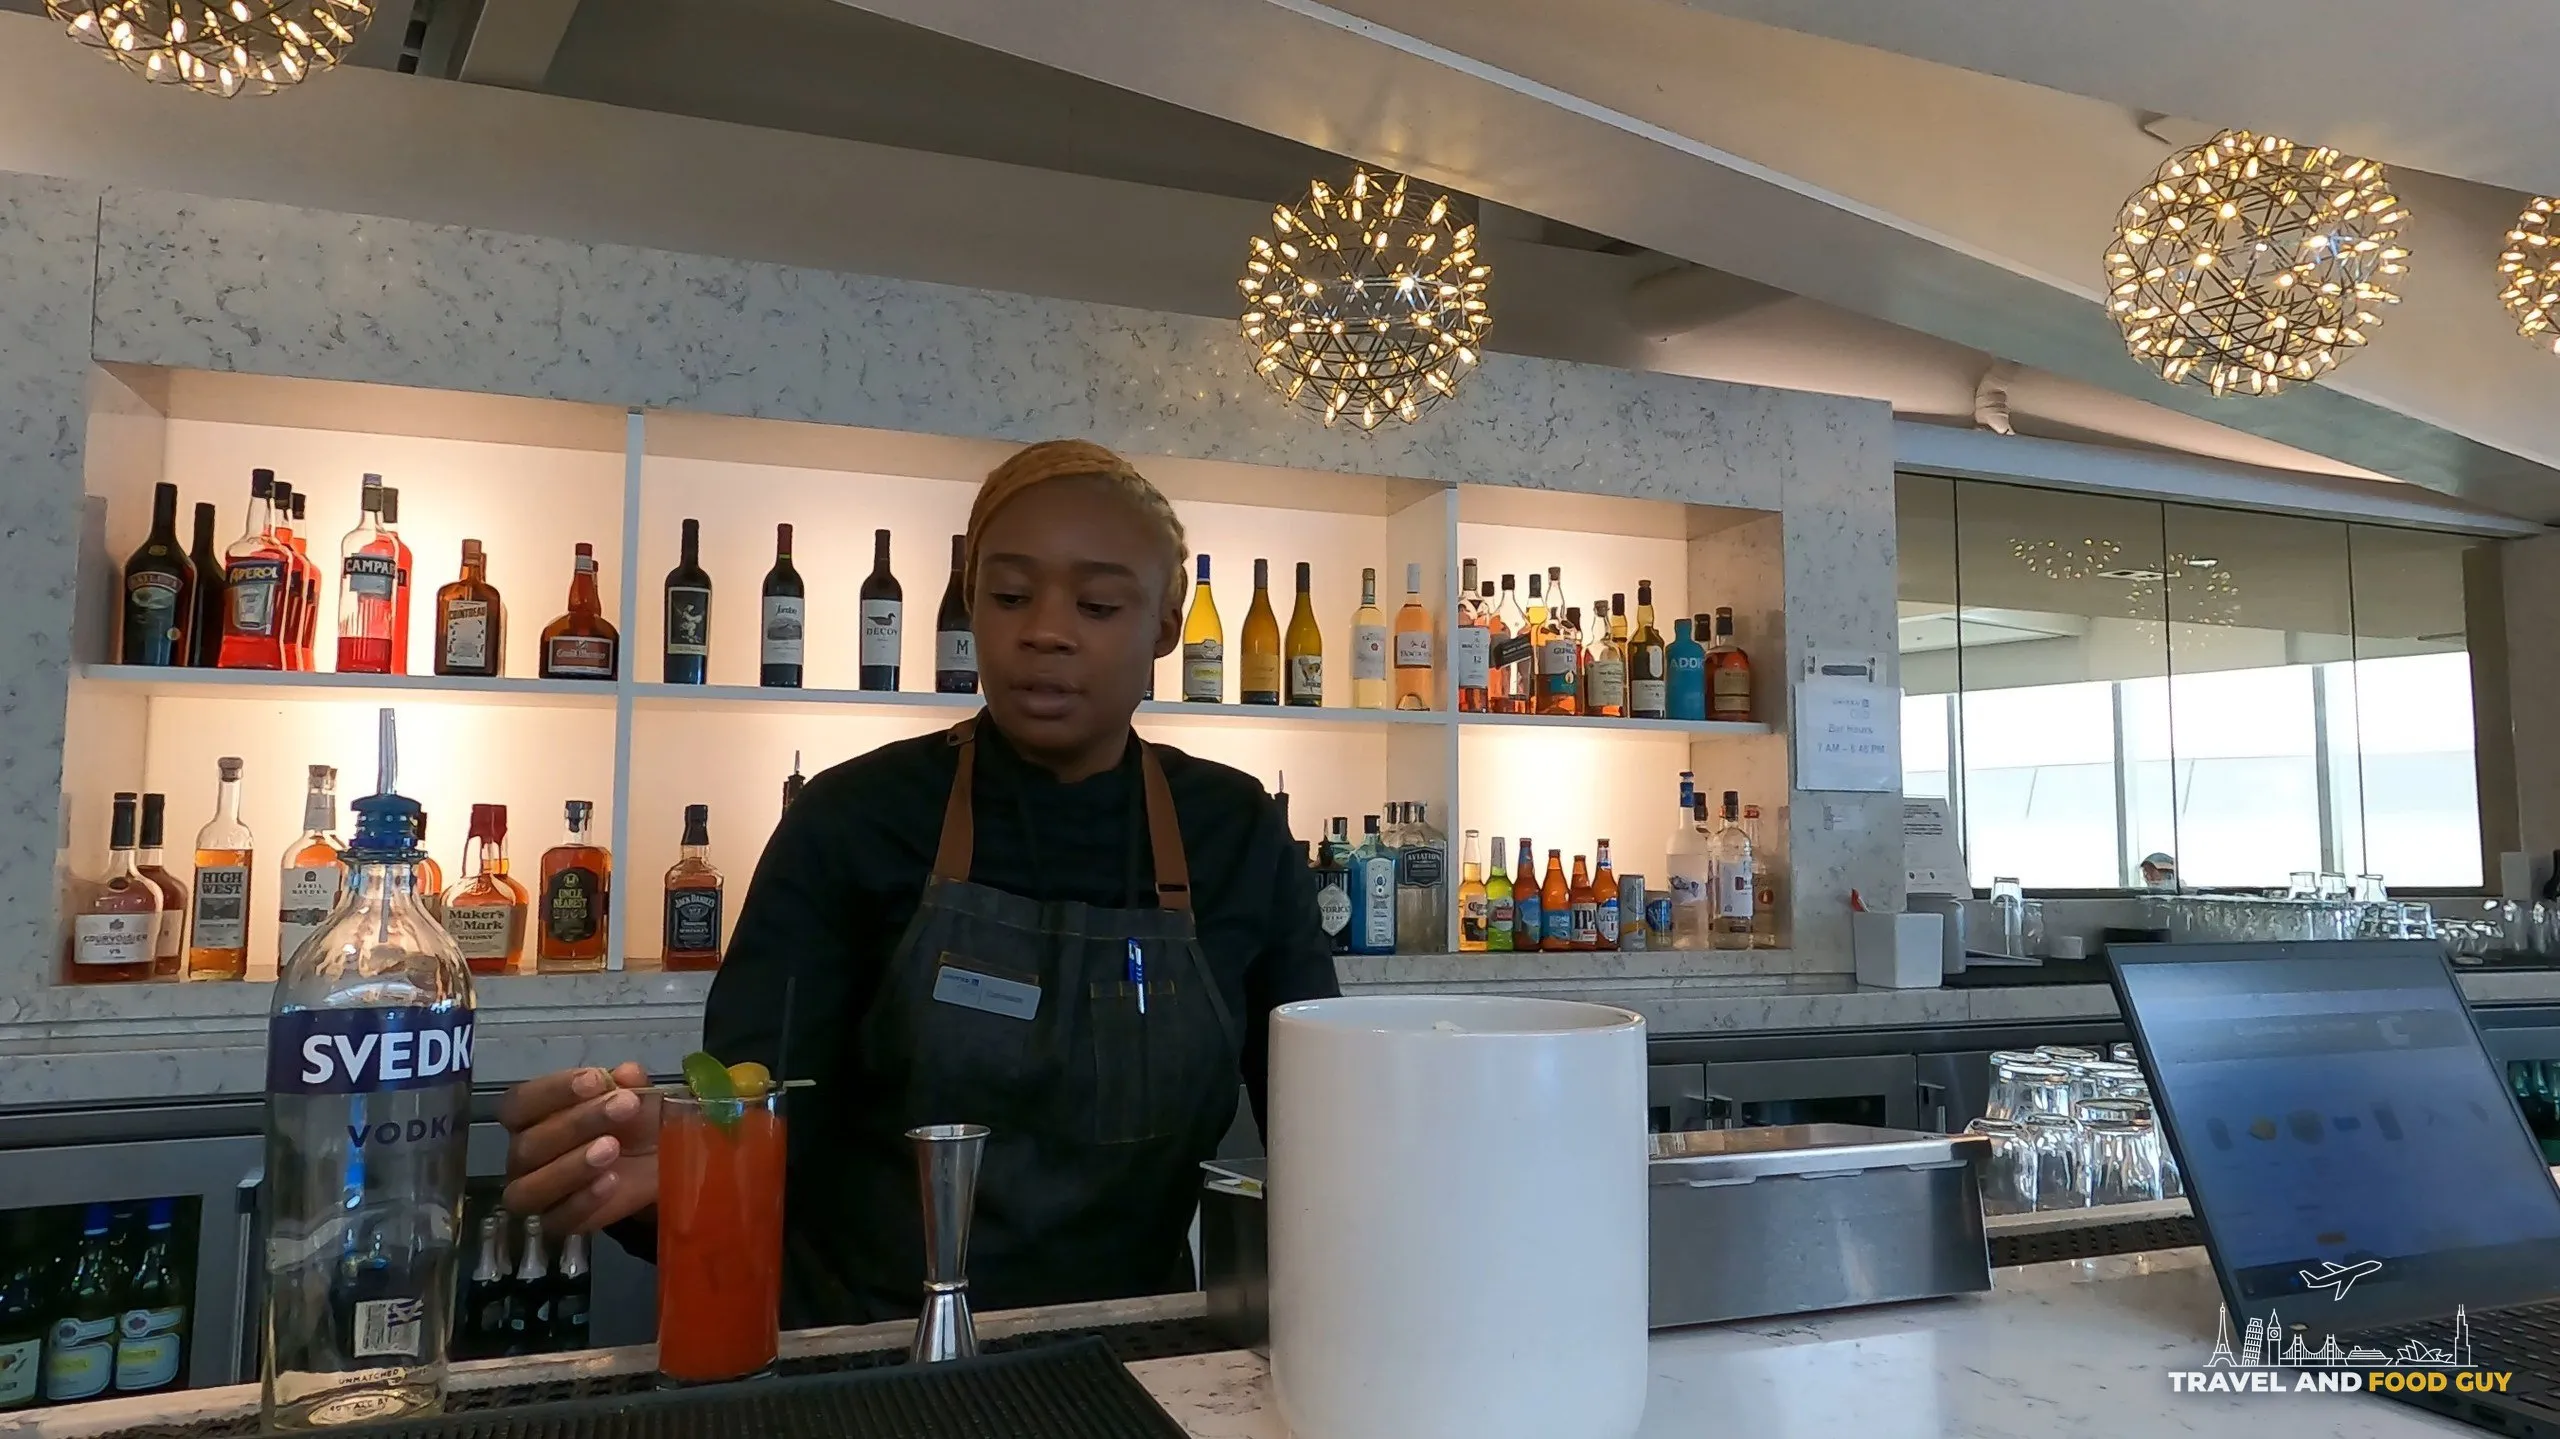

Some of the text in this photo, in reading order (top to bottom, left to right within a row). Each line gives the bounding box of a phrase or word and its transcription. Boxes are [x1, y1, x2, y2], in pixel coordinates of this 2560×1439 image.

[229, 566, 279, 584] APEROL
[866, 627, 898, 636] DECOY
[956, 639, 969, 655] M
[1825, 743, 1840, 752] AM
[1871, 743, 1885, 754] PM
[1407, 853, 1441, 862] AVIATION
[201, 871, 243, 884] HIGH
[201, 883, 242, 895] WEST
[558, 888, 583, 899] UNCLE
[553, 899, 587, 908] NEAREST
[449, 909, 505, 920] Maker's
[463, 920, 504, 931] Mark
[302, 1024, 474, 1084] SVEDK
[338, 1368, 399, 1385] UNMATCHED
